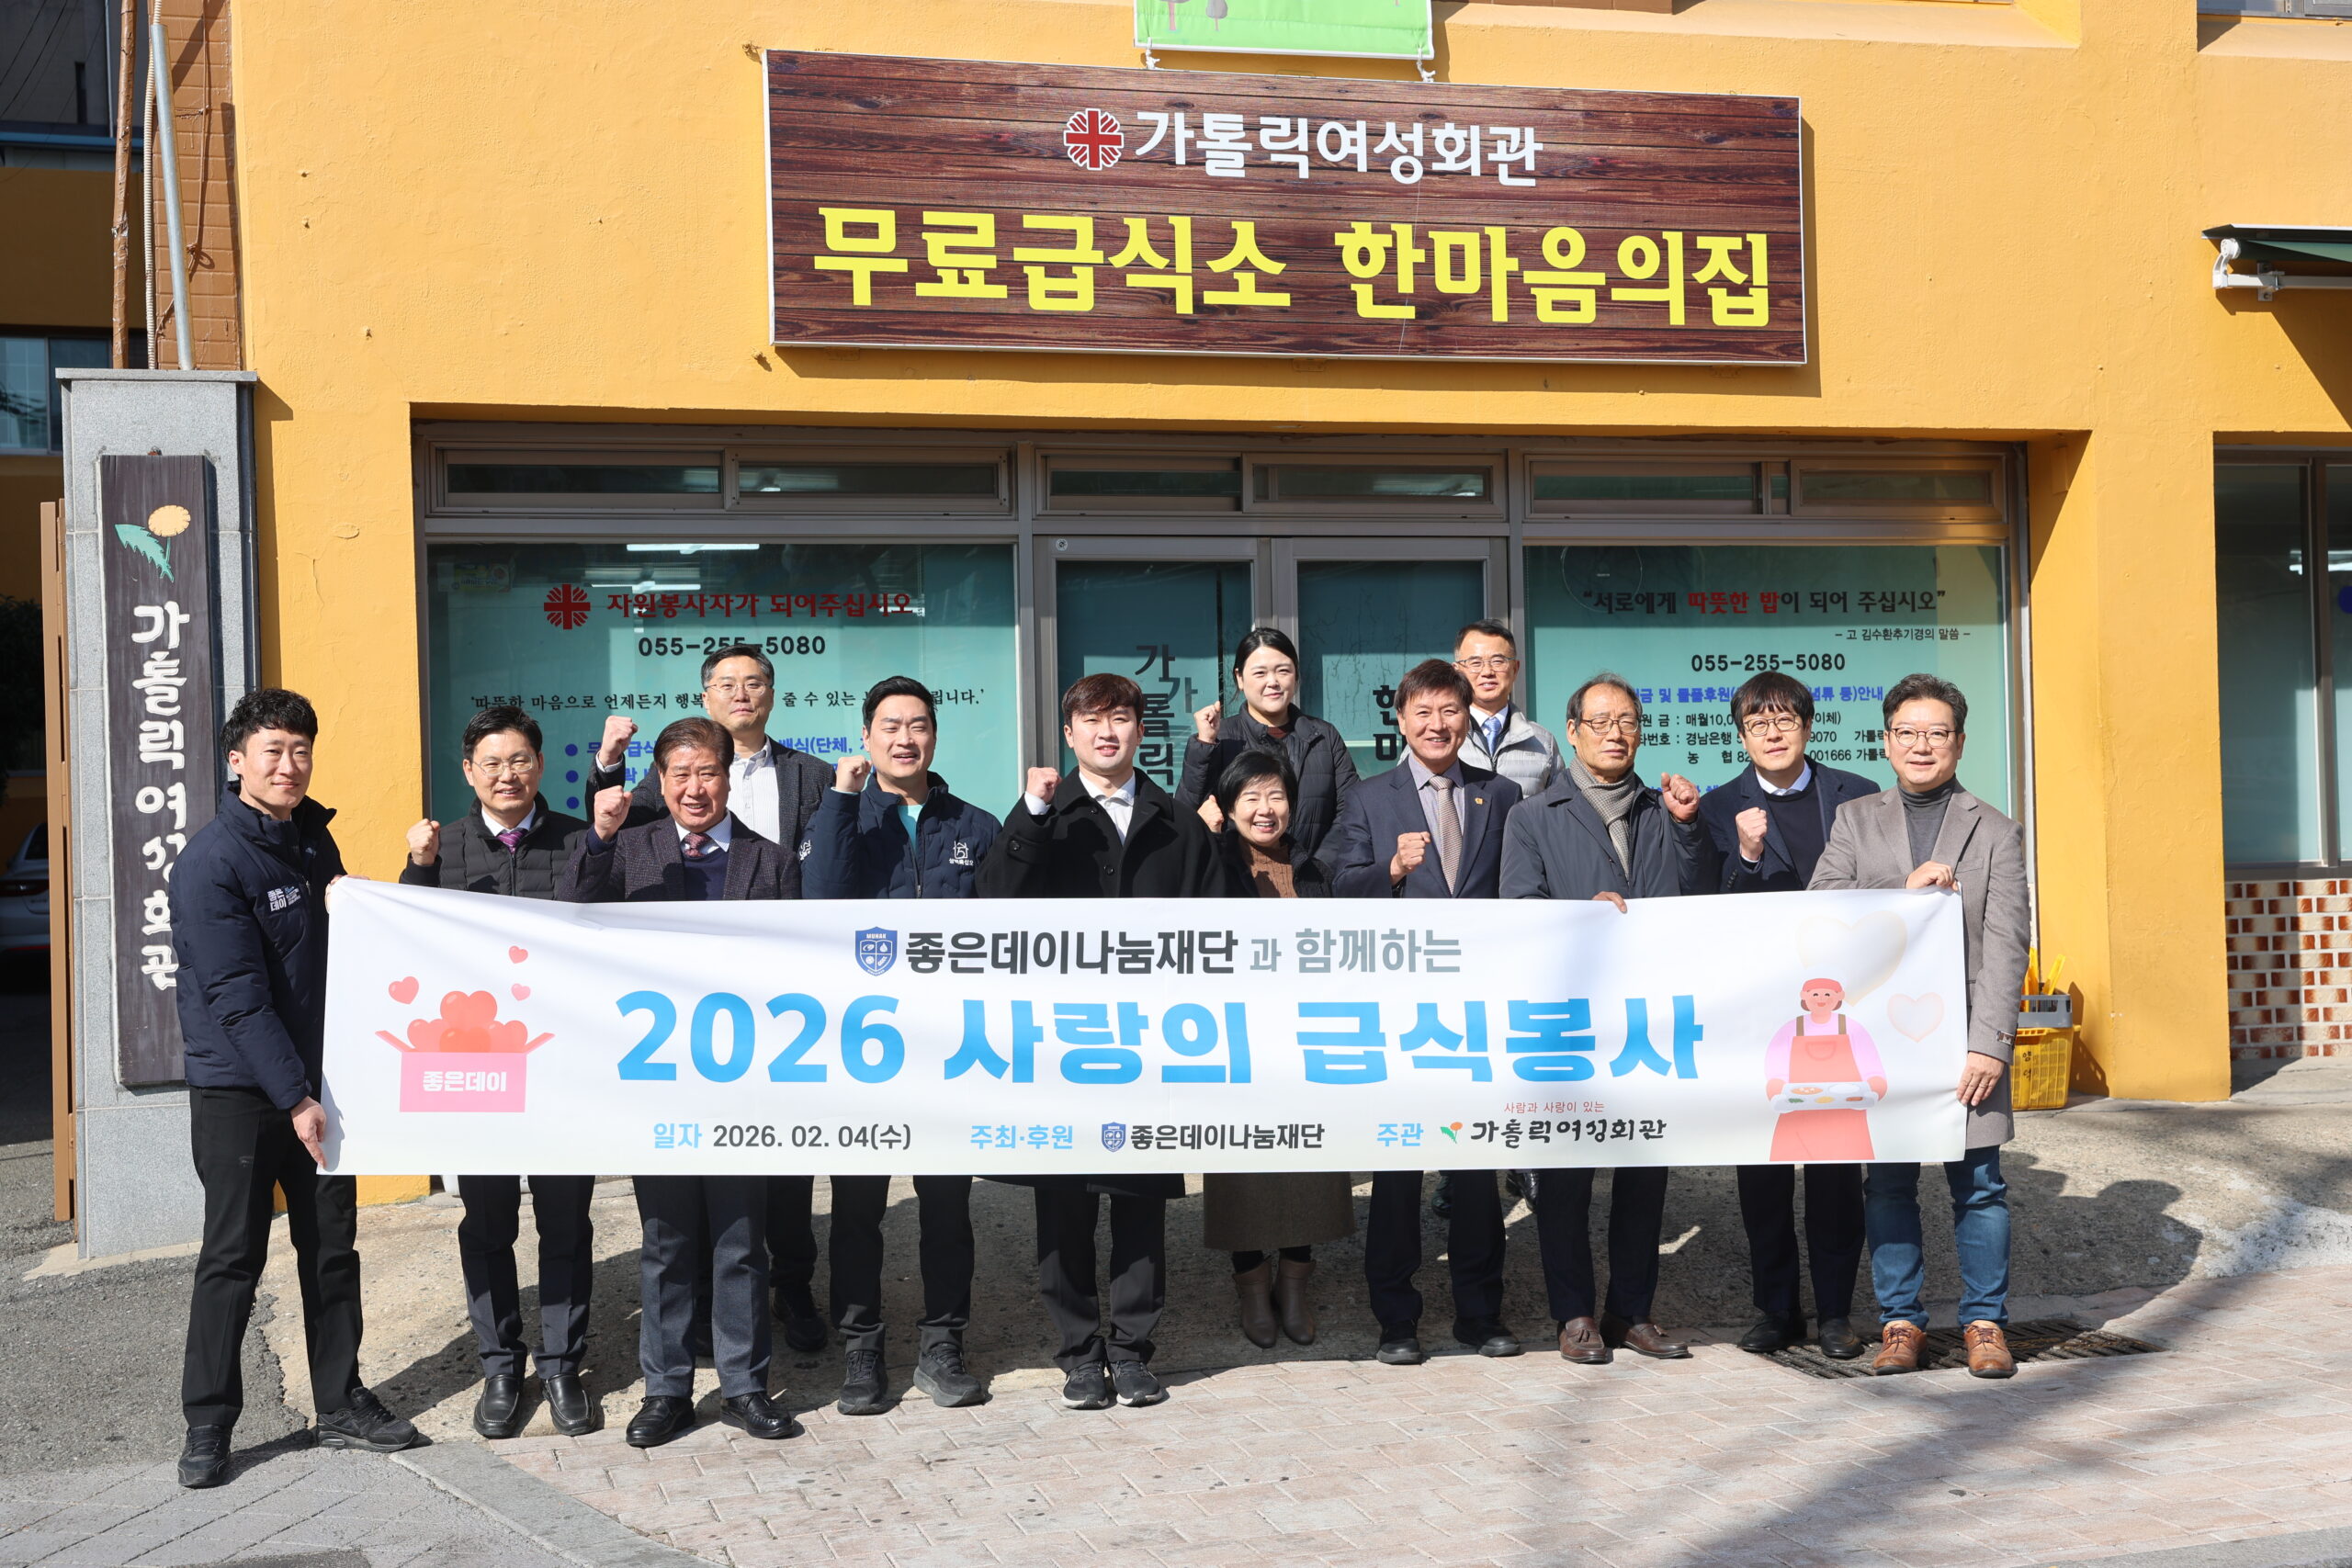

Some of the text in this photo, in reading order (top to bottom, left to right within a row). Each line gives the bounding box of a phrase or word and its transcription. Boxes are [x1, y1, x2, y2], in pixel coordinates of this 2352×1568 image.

[1136, 110, 1544, 187] 가톨릭여성회관
[814, 207, 1770, 327] 무료급식소 한마음의집
[607, 592, 914, 619] 자원봉사자가 되어주십시오
[1688, 591, 1749, 615] 따뜻한
[1759, 591, 1801, 615] 밥이
[1809, 591, 1849, 614] 되어
[1846, 628, 1858, 640] 고
[1861, 627, 1935, 641] 김수환추기경의
[1939, 627, 1960, 641] 말씀
[1691, 653, 1846, 672] 055-255-5080
[531, 694, 596, 711] 마음으로
[605, 694, 666, 710] 언제든지
[782, 692, 797, 707] 줄
[804, 692, 819, 707] 수
[826, 691, 856, 706] 있는
[1658, 688, 1671, 704] 및
[1658, 714, 1670, 728] 금
[1686, 732, 1732, 746] 경남은행
[1688, 751, 1700, 764] 농
[906, 929, 1462, 975] 좋은데이나눔재단 과 함께하는
[616, 989, 1704, 1086] 2026 사랑의 급식봉사
[423, 1071, 507, 1091] 좋은데이
[1503, 1101, 1605, 1113] 사람과 사랑이 있는
[653, 1123, 911, 1151] 일자 2026. 02. 04(수)
[969, 1123, 1073, 1150] 주최·후원
[1131, 1123, 1325, 1150] 좋은데이나눔재단
[1376, 1122, 1425, 1147] 주관
[1471, 1118, 1668, 1149] 가톨릭여성회관
